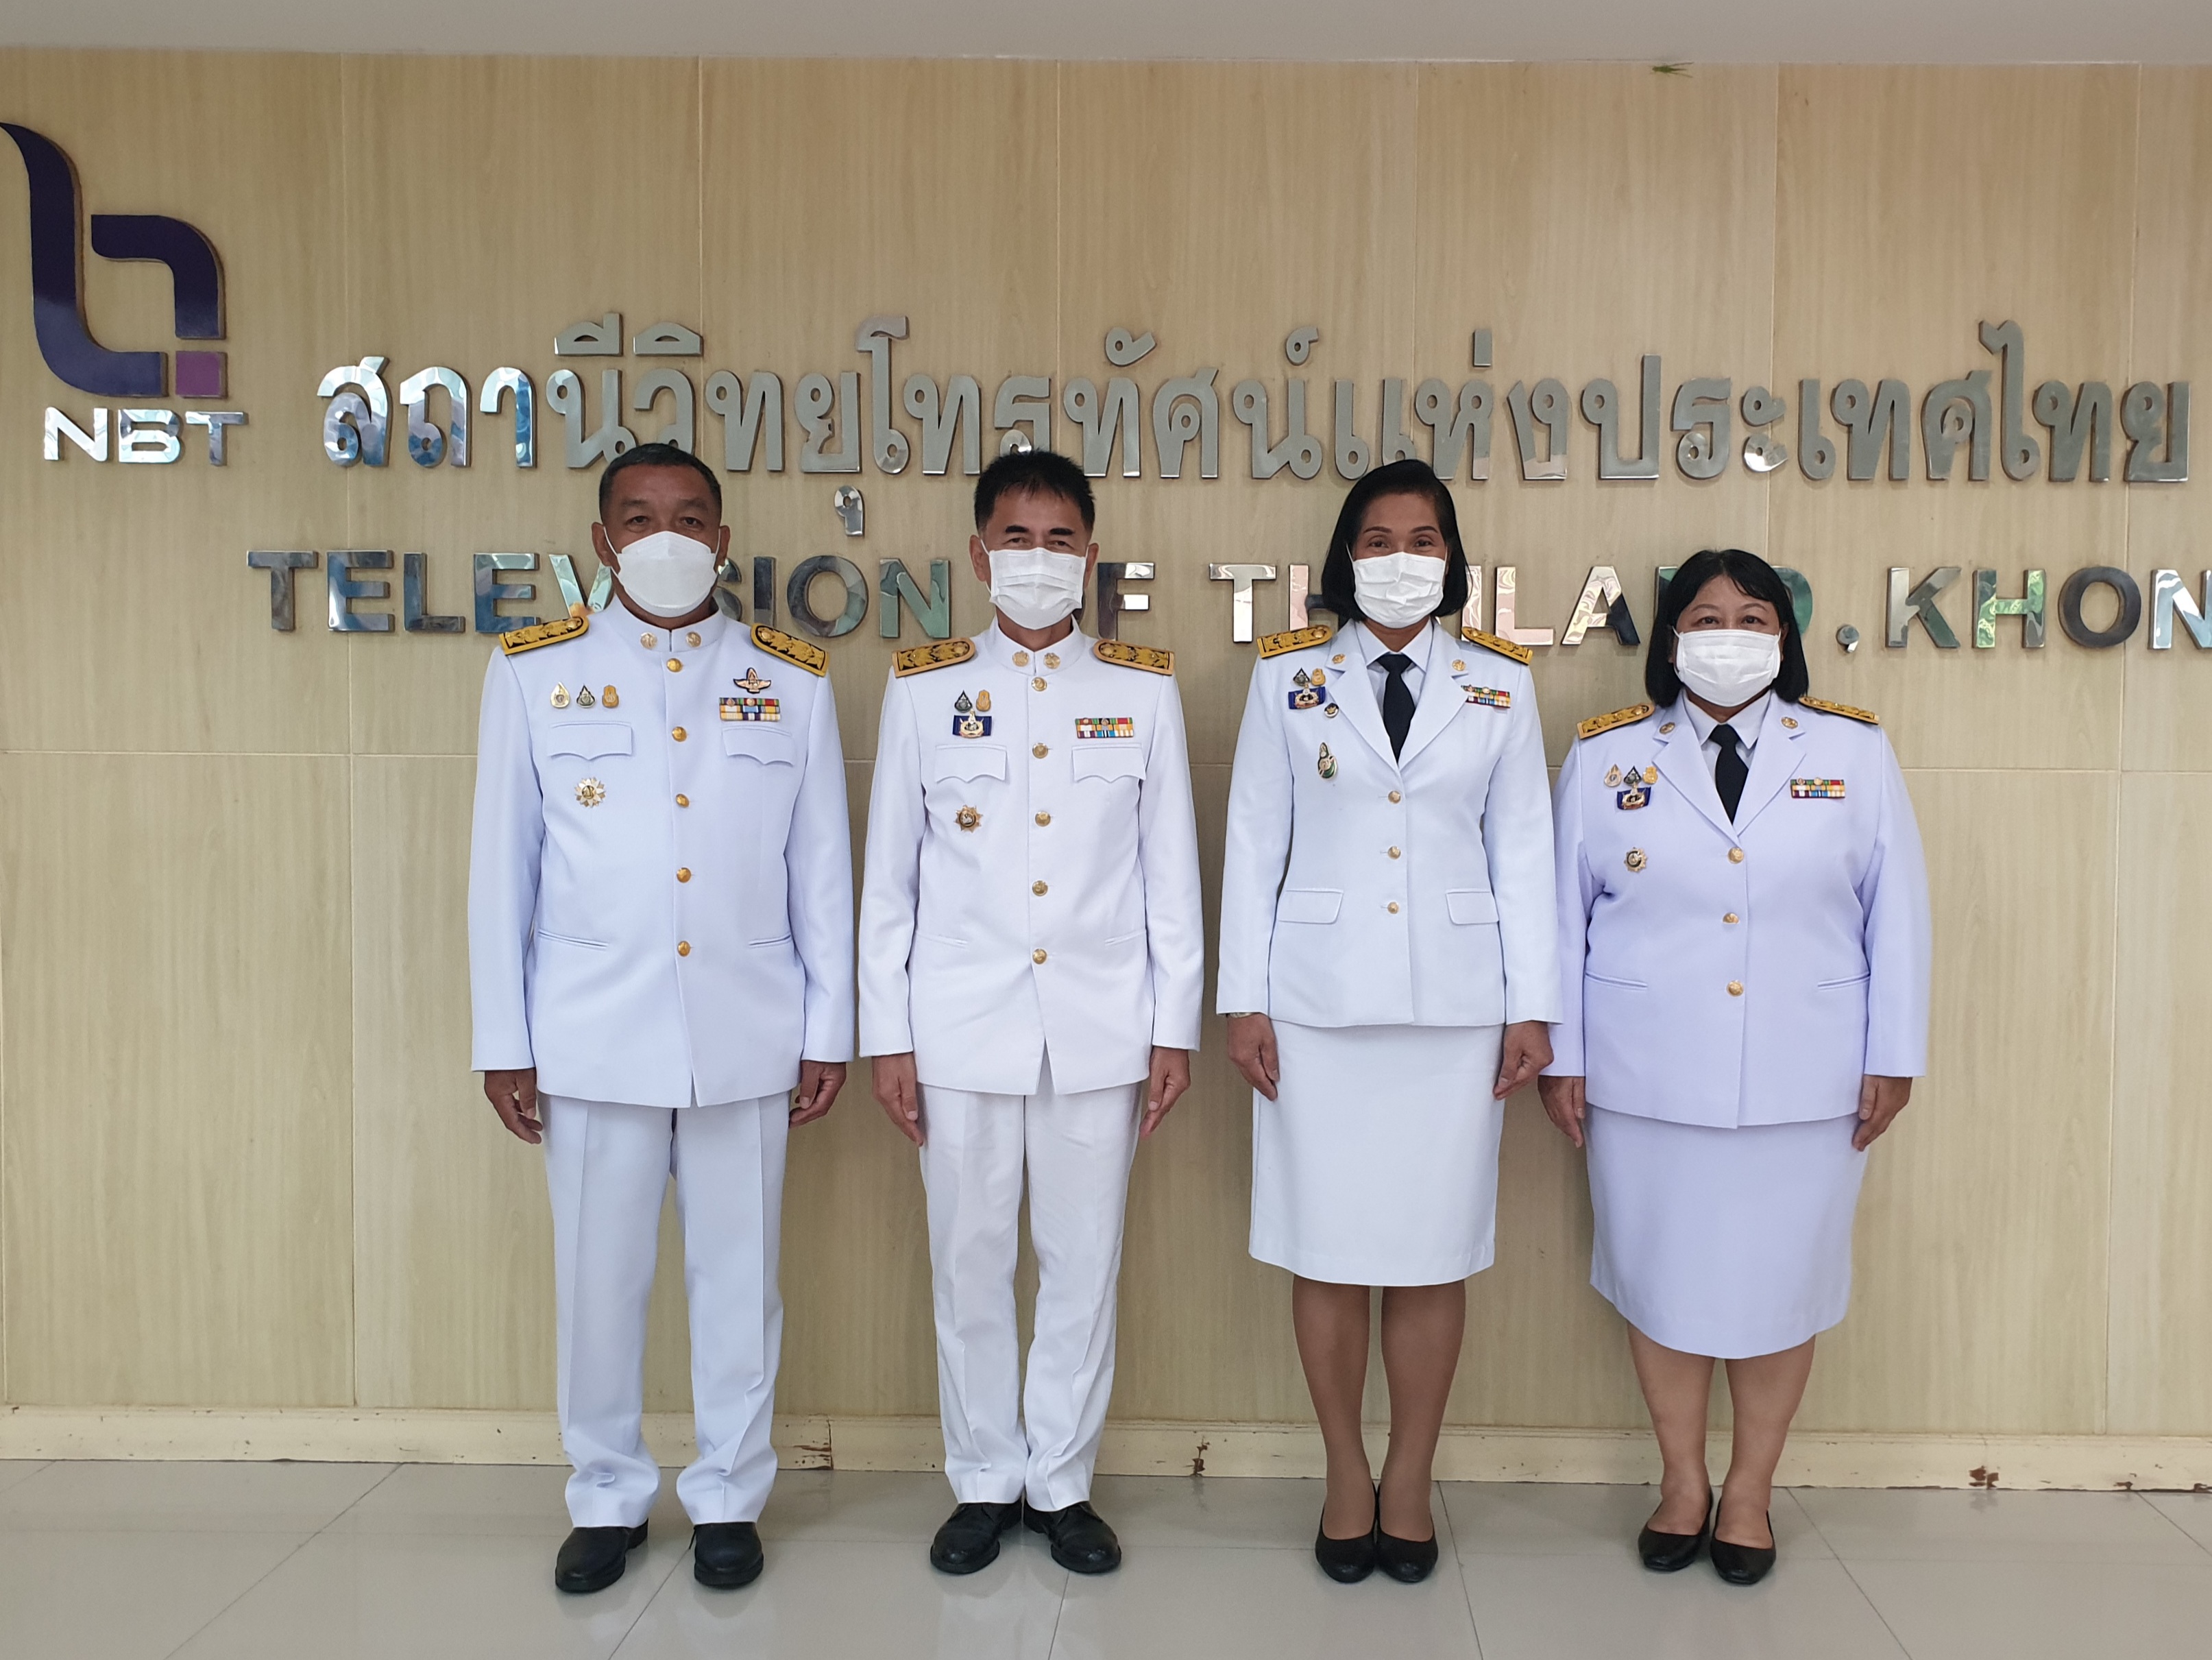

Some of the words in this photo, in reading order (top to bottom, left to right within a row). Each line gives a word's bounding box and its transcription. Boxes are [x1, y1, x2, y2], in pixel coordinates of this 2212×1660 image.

[44, 406, 249, 467] NBT
[246, 550, 953, 640] TELEVION
[1072, 562, 1156, 642] F
